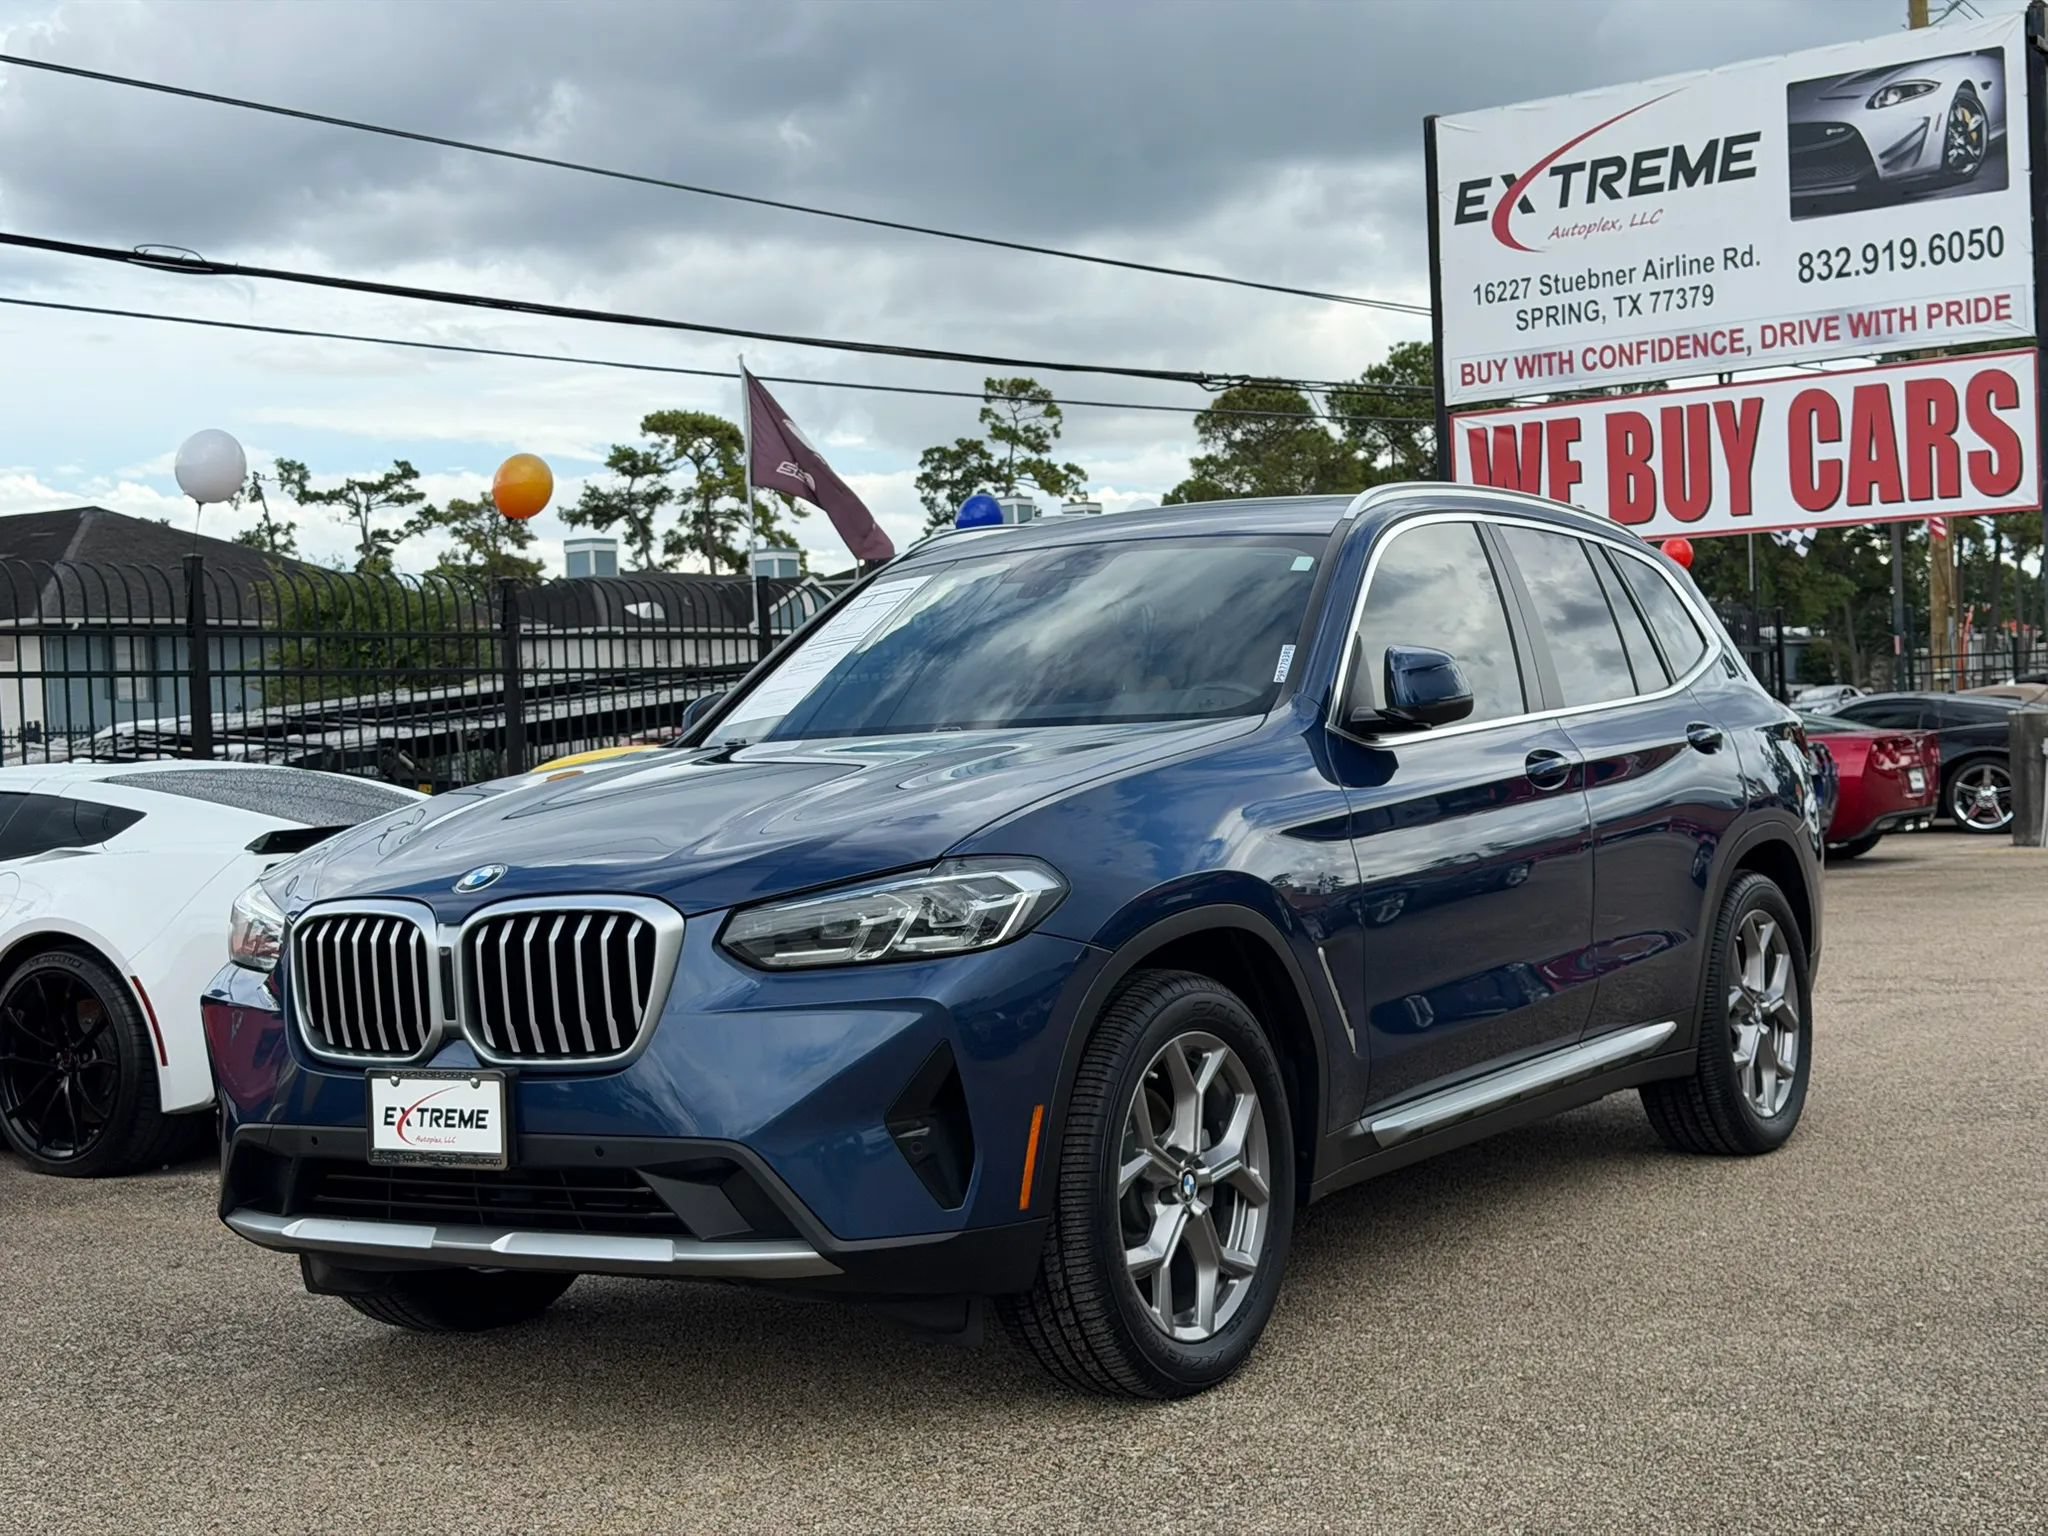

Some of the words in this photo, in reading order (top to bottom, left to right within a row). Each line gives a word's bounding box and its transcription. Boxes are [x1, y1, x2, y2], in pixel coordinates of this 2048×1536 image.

[1454, 132, 1761, 226] EXTREME
[1548, 217, 1622, 241] Autoplex,
[1629, 209, 1664, 227] LLC
[1473, 277, 1531, 305] 16227
[1539, 267, 1636, 295] Stuebner
[1643, 254, 1715, 282] Airline
[1723, 245, 1760, 271] Rd.
[1798, 226, 2005, 283] 832.919.6050
[1516, 301, 1606, 331] SPRING,
[1614, 293, 1642, 317] TX
[1651, 285, 1714, 313] 77379
[1460, 359, 1507, 386] BUY
[1513, 350, 1575, 380] WITH
[1582, 329, 1753, 371] CONFIDENCE,
[1761, 316, 1841, 348] DRIVE
[1848, 306, 1918, 339] WITH
[1926, 294, 2012, 328] PRIDE
[1468, 418, 1582, 502] WE
[1606, 397, 1764, 524] BUY
[1788, 369, 2023, 512] CARS
[384, 1107, 489, 1129] EXTREME
